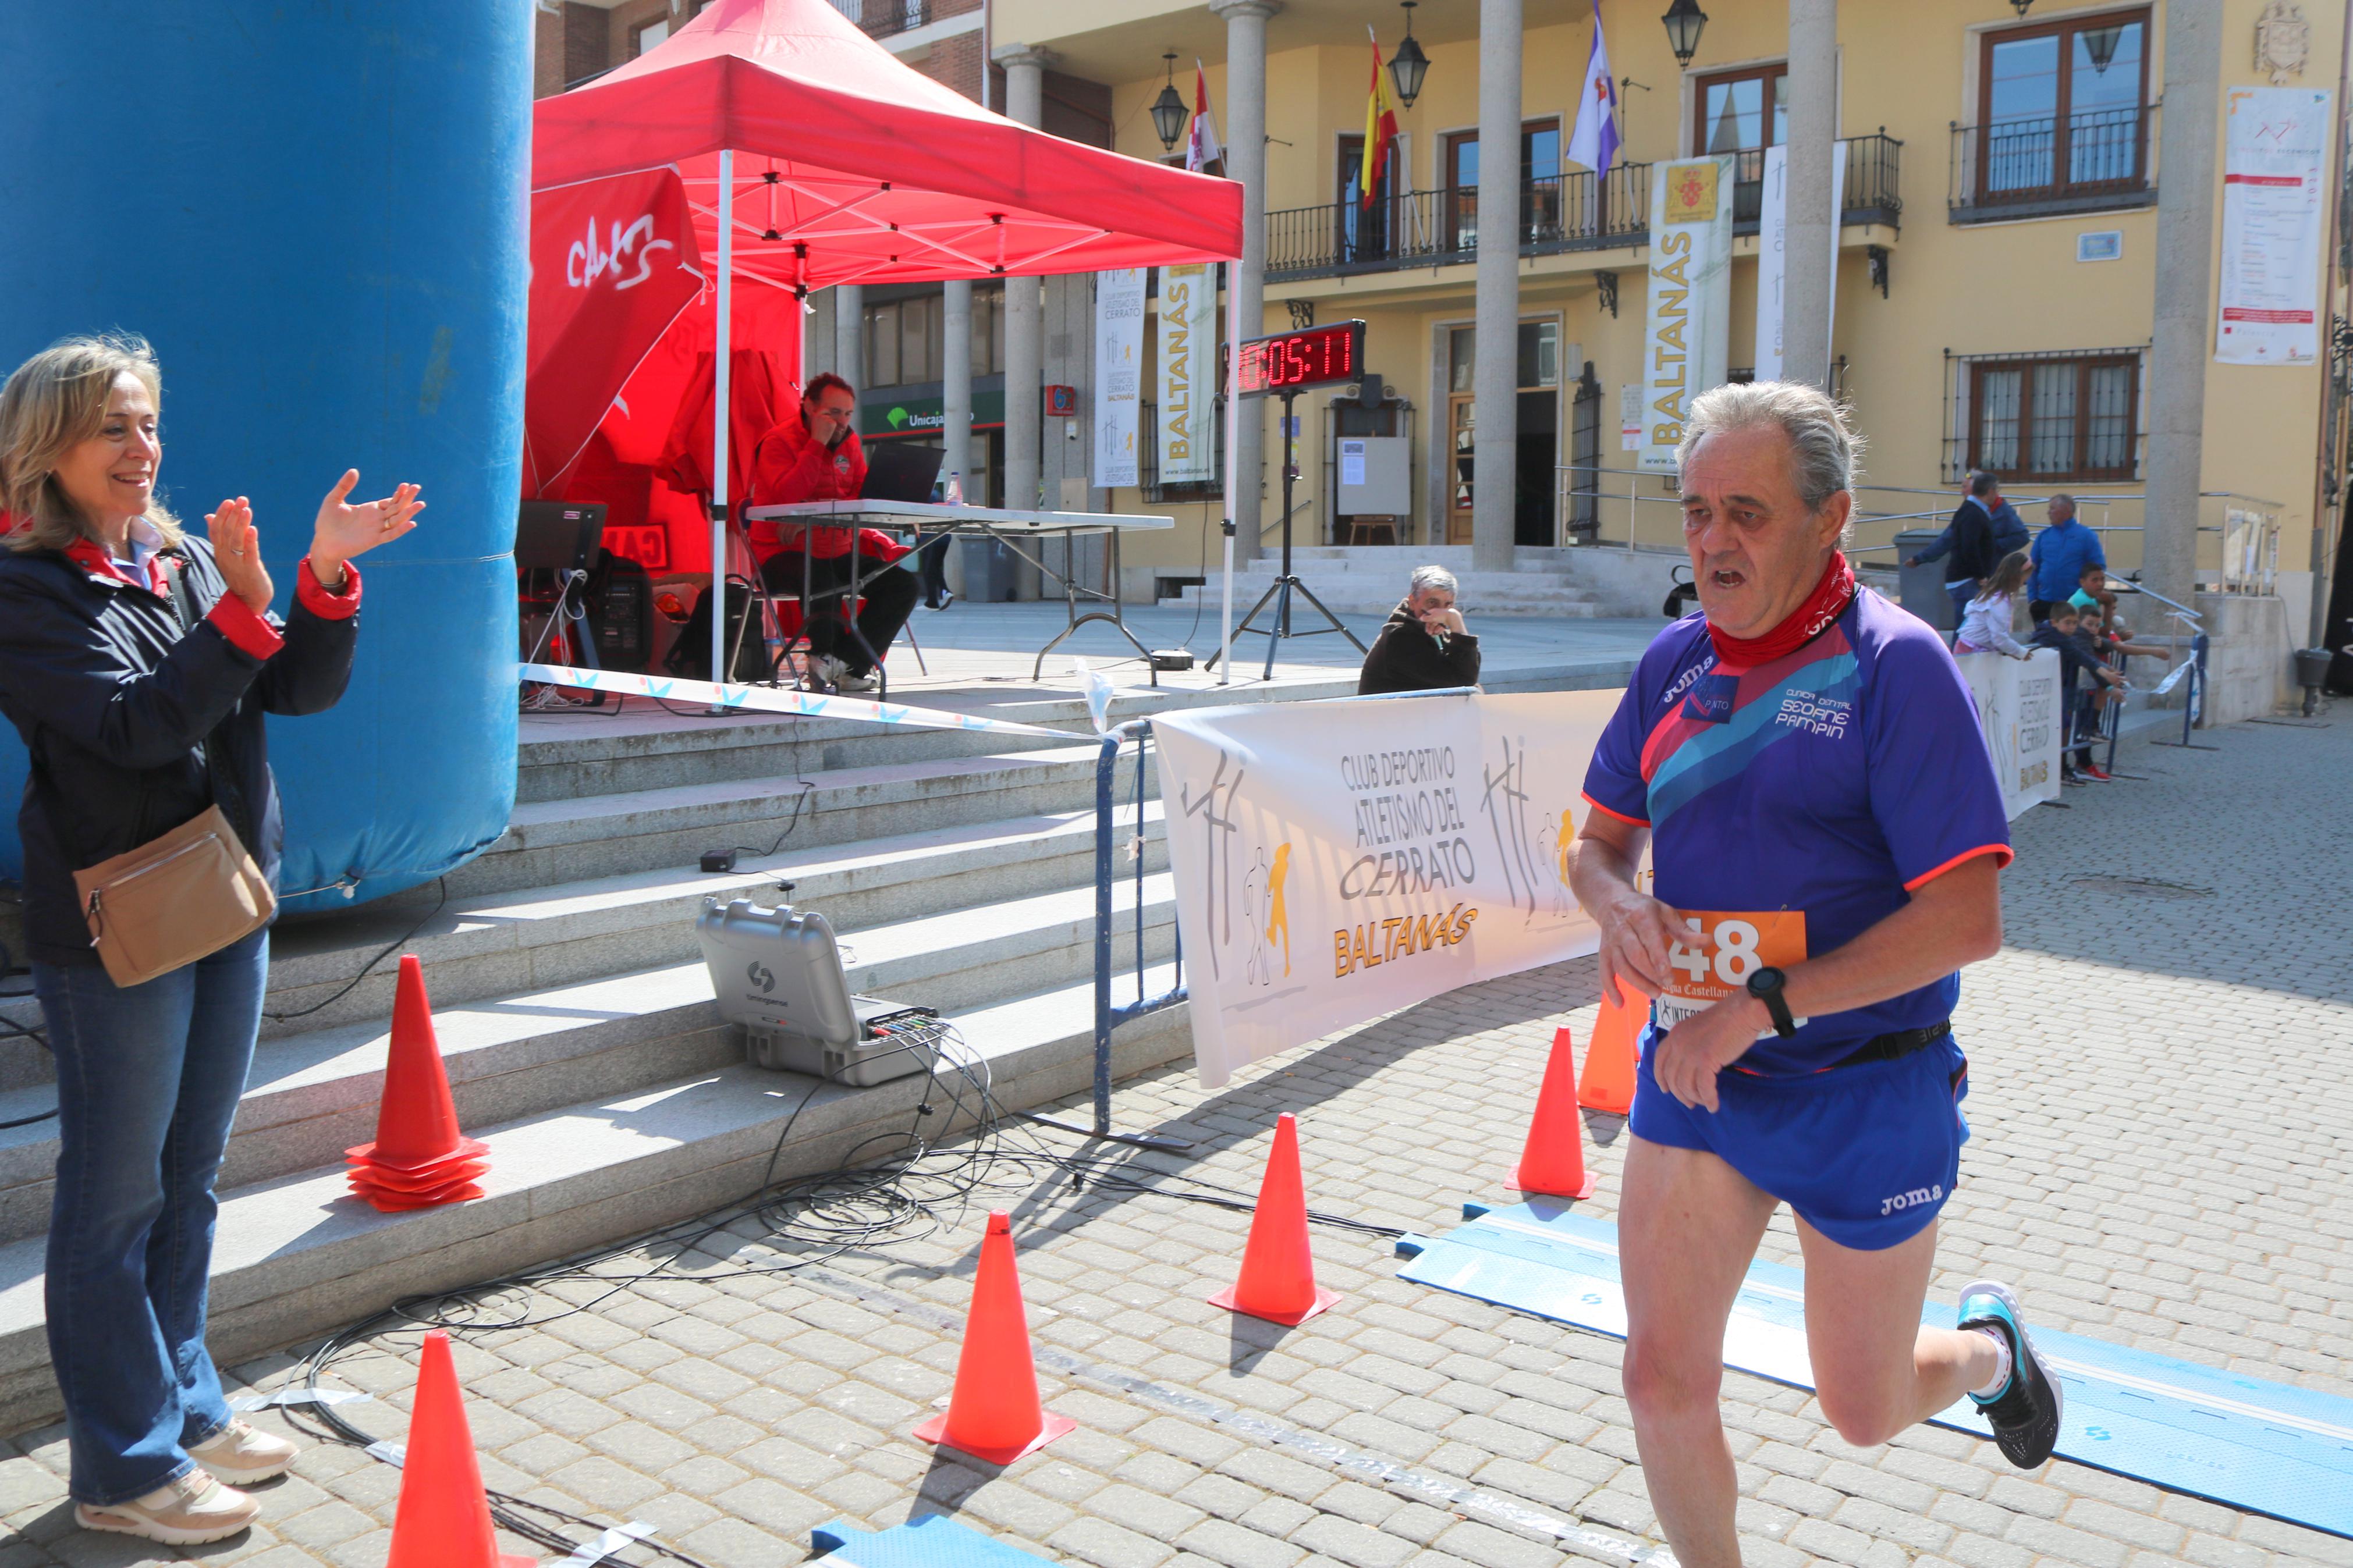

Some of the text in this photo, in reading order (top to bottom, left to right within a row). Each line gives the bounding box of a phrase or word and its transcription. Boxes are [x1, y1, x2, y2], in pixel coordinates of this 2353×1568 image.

[1105, 307, 1141, 319] CERRATO
[1652, 232, 1692, 445] BALTANÁS
[1108, 384, 1135, 393] CERRATO
[1163, 283, 1189, 460] BALTANÁS
[909, 410, 945, 427] Unicaja
[1704, 699, 1729, 710] PNTO
[1781, 699, 1850, 725] SEOANE
[1818, 698, 1852, 711] DENTAL
[1775, 713, 1844, 739] PAMPIN
[1341, 746, 1455, 791] CLUB DEPORTIVO
[1355, 787, 1465, 848] ATLETISMO DEL
[1340, 837, 1475, 900] CERRATO
[1334, 902, 1478, 978] BALTANÁS
[1668, 918, 1763, 986] 48
